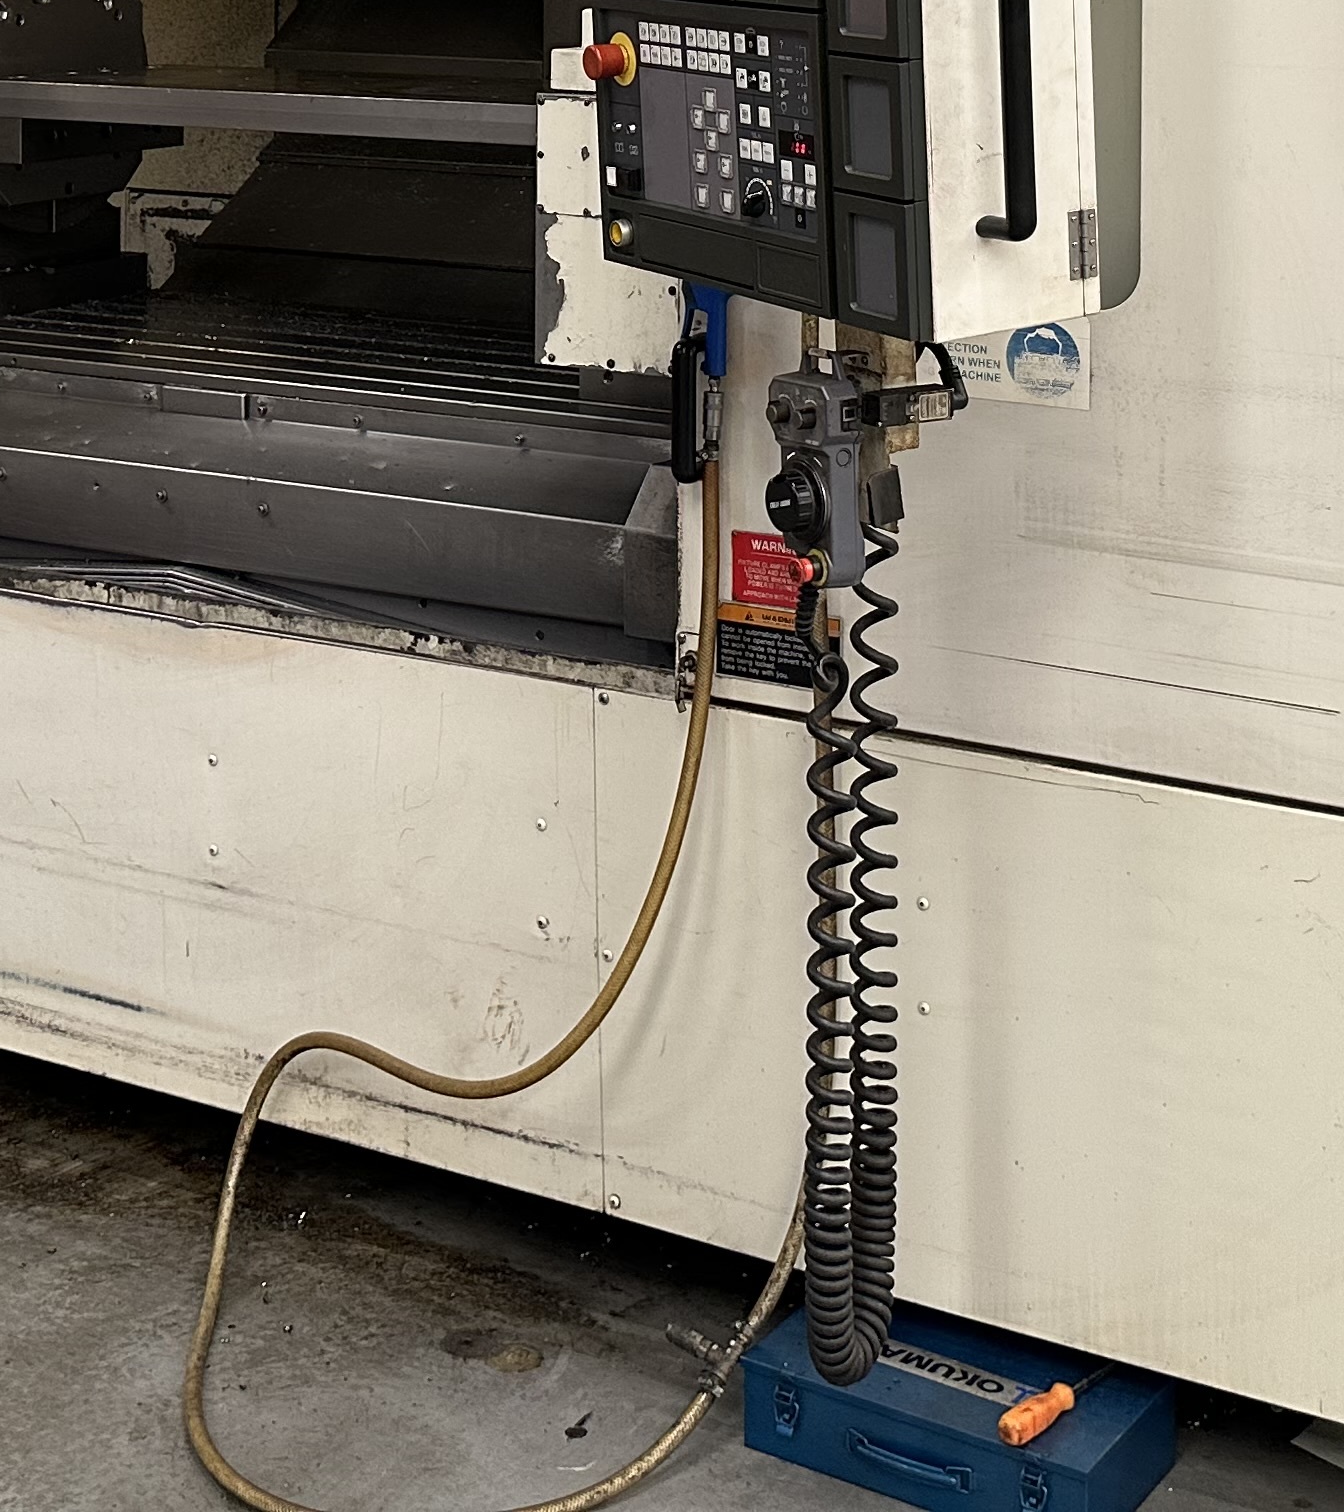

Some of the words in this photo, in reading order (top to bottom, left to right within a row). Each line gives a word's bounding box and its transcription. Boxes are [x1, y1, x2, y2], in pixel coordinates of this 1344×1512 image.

[947, 342, 987, 355] ECTION
[968, 357, 1001, 370] WHEN
[961, 369, 1001, 383] ACHINE
[743, 635, 751, 643] be
[752, 637, 776, 647] opened
[745, 629, 783, 642] automatically
[744, 651, 755, 659] the
[756, 652, 767, 661] key
[766, 647, 777, 655] the
[721, 661, 736, 670] Take
[737, 664, 747, 672] the
[748, 667, 760, 676] key
[761, 669, 775, 677] with
[880, 1343, 1005, 1393] OKUMA
